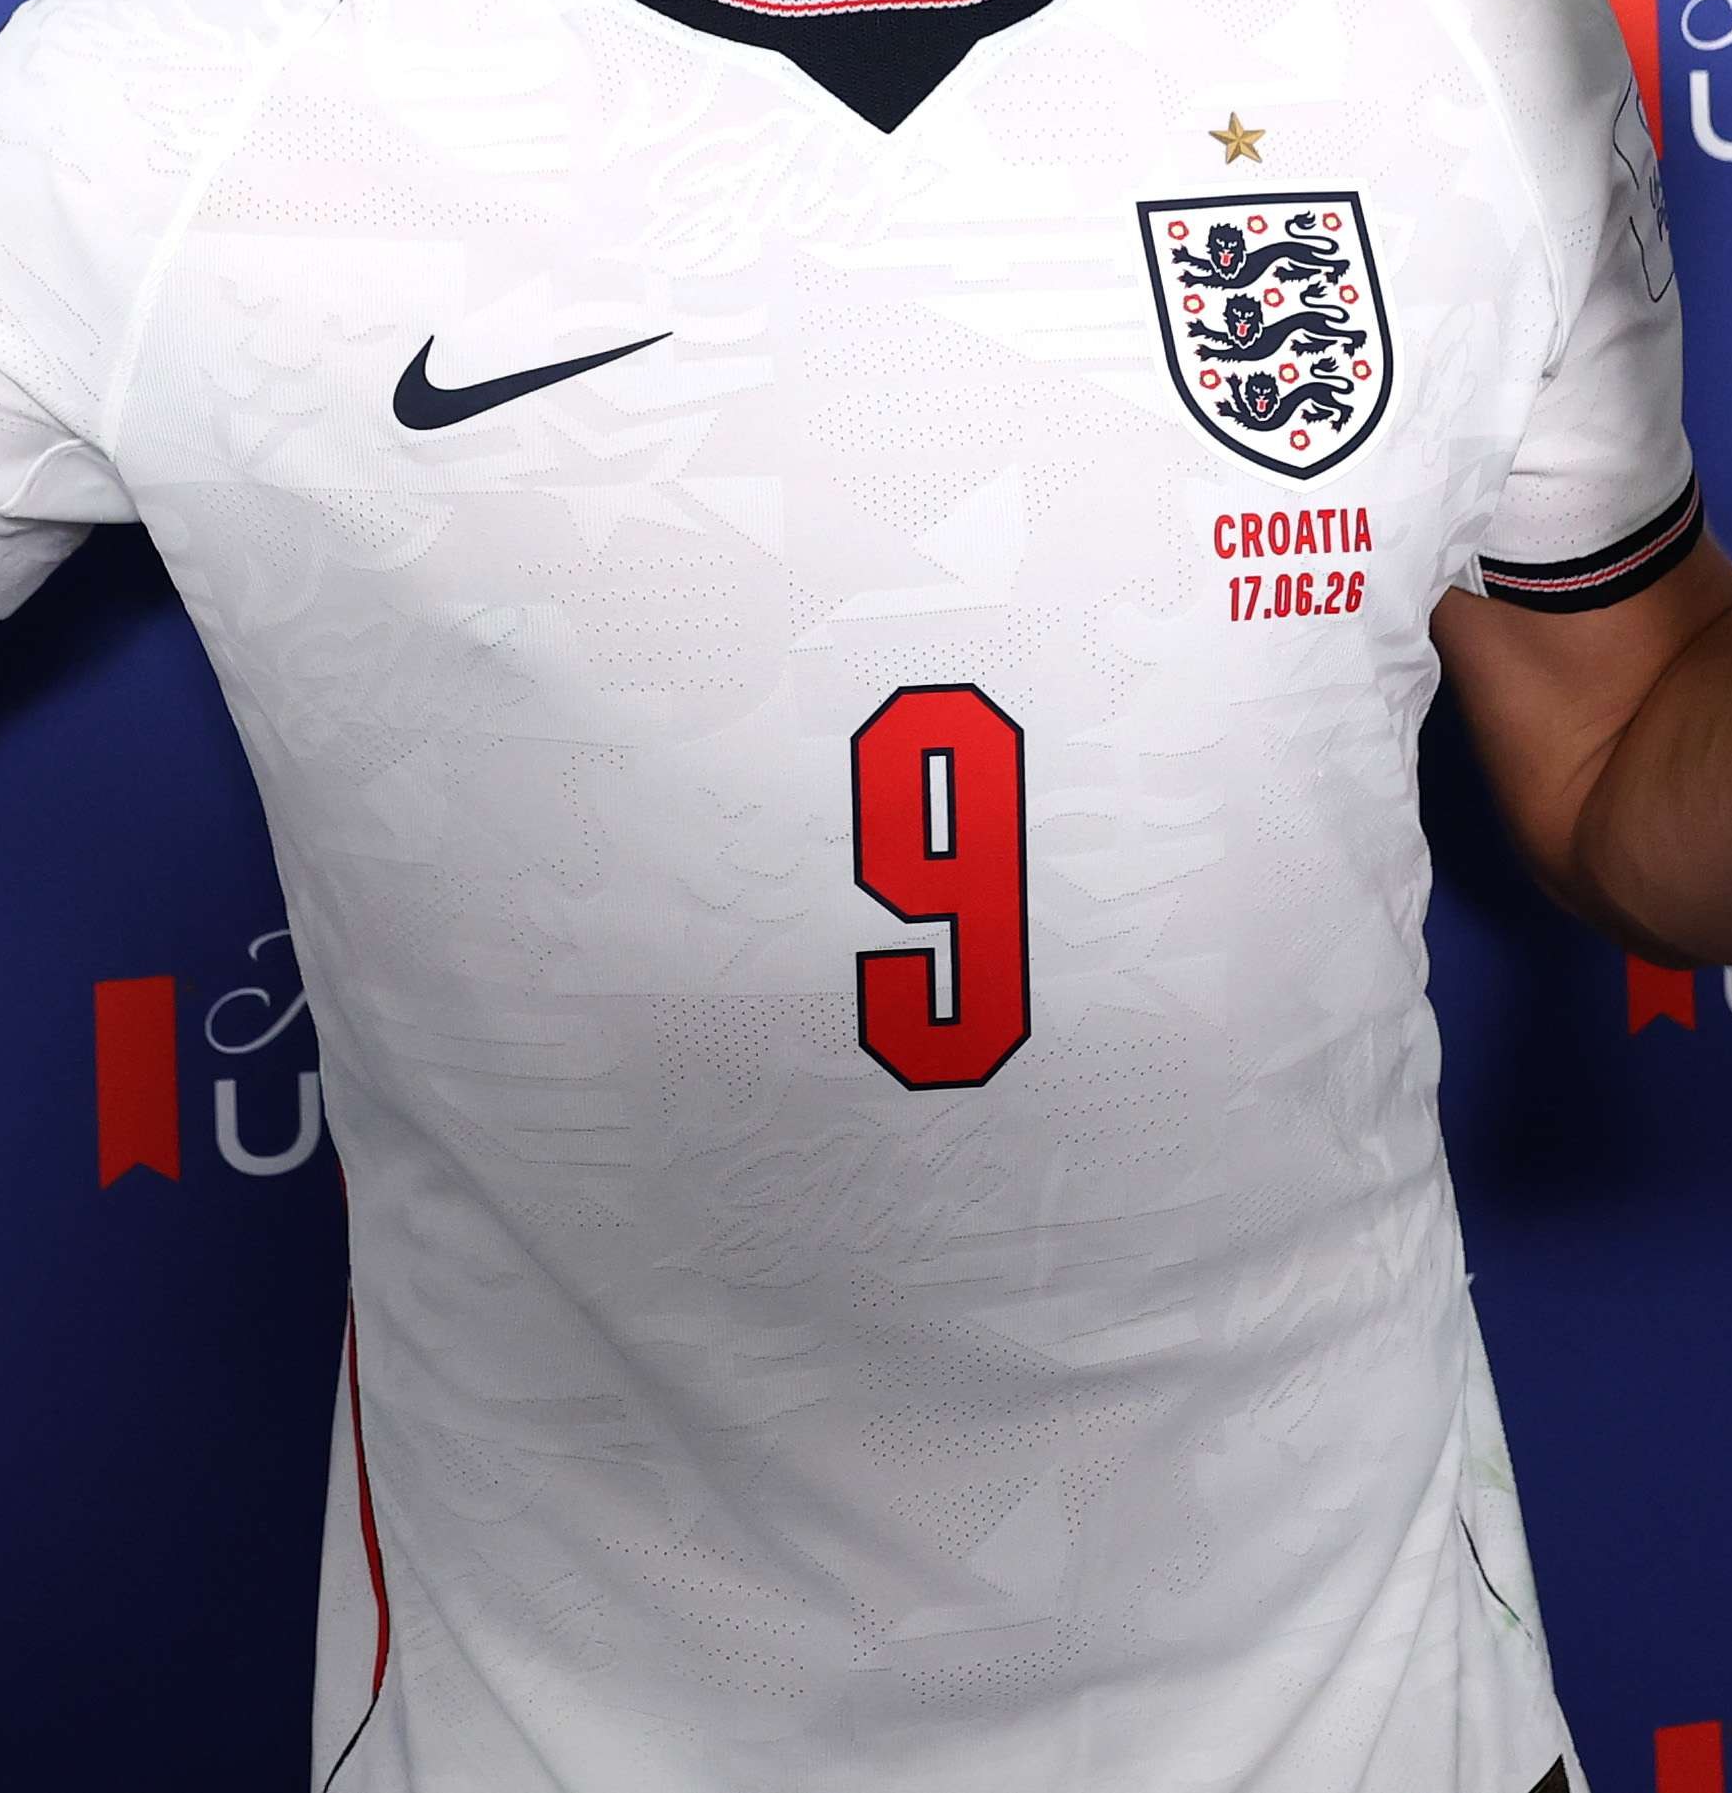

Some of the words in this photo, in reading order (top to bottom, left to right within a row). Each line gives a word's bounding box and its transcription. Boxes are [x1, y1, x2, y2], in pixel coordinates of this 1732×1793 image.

[1213, 507, 1373, 560] CROATIA
[1228, 570, 1365, 622] 17.06.26
[850, 683, 1032, 1092] 9
